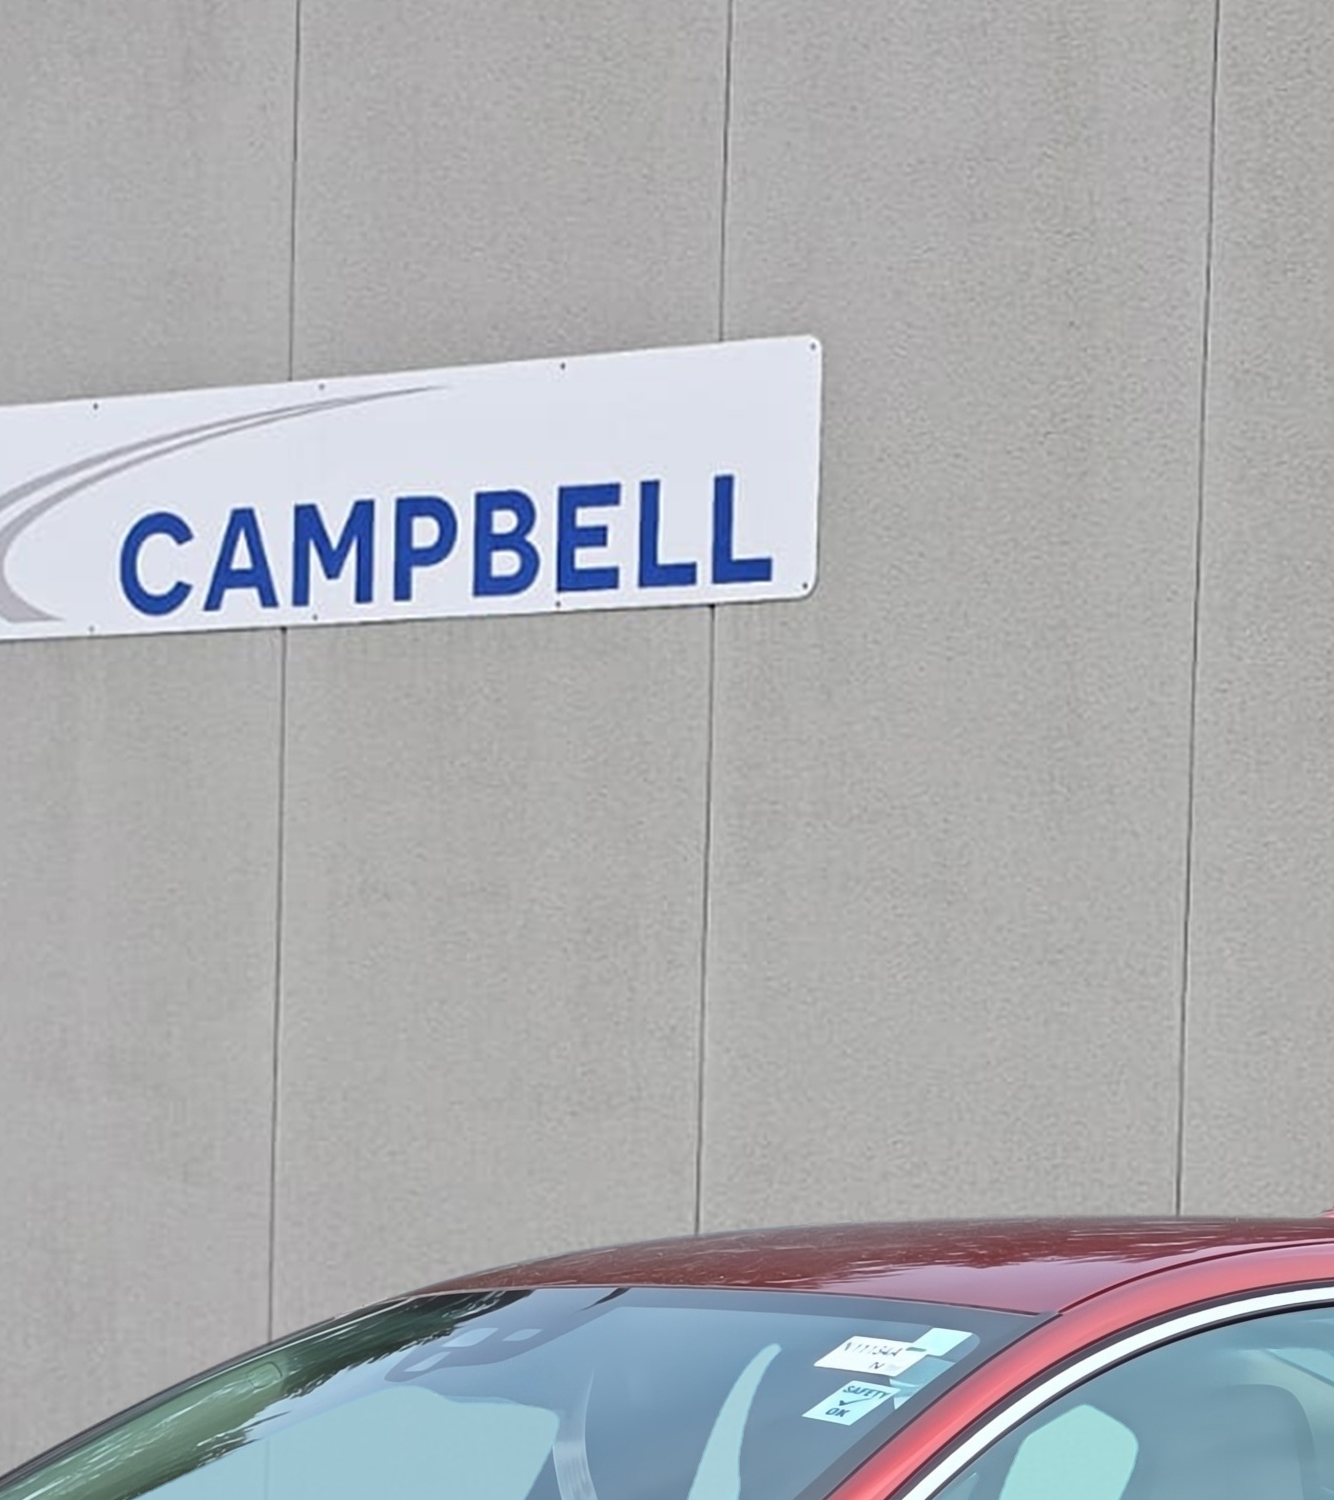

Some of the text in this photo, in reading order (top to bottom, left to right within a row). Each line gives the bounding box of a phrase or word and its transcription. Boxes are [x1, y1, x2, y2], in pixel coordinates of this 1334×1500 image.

[120, 474, 773, 616] CAMPBELL
[842, 1385, 891, 1400] SAFETY
[825, 1407, 851, 1418] OK
